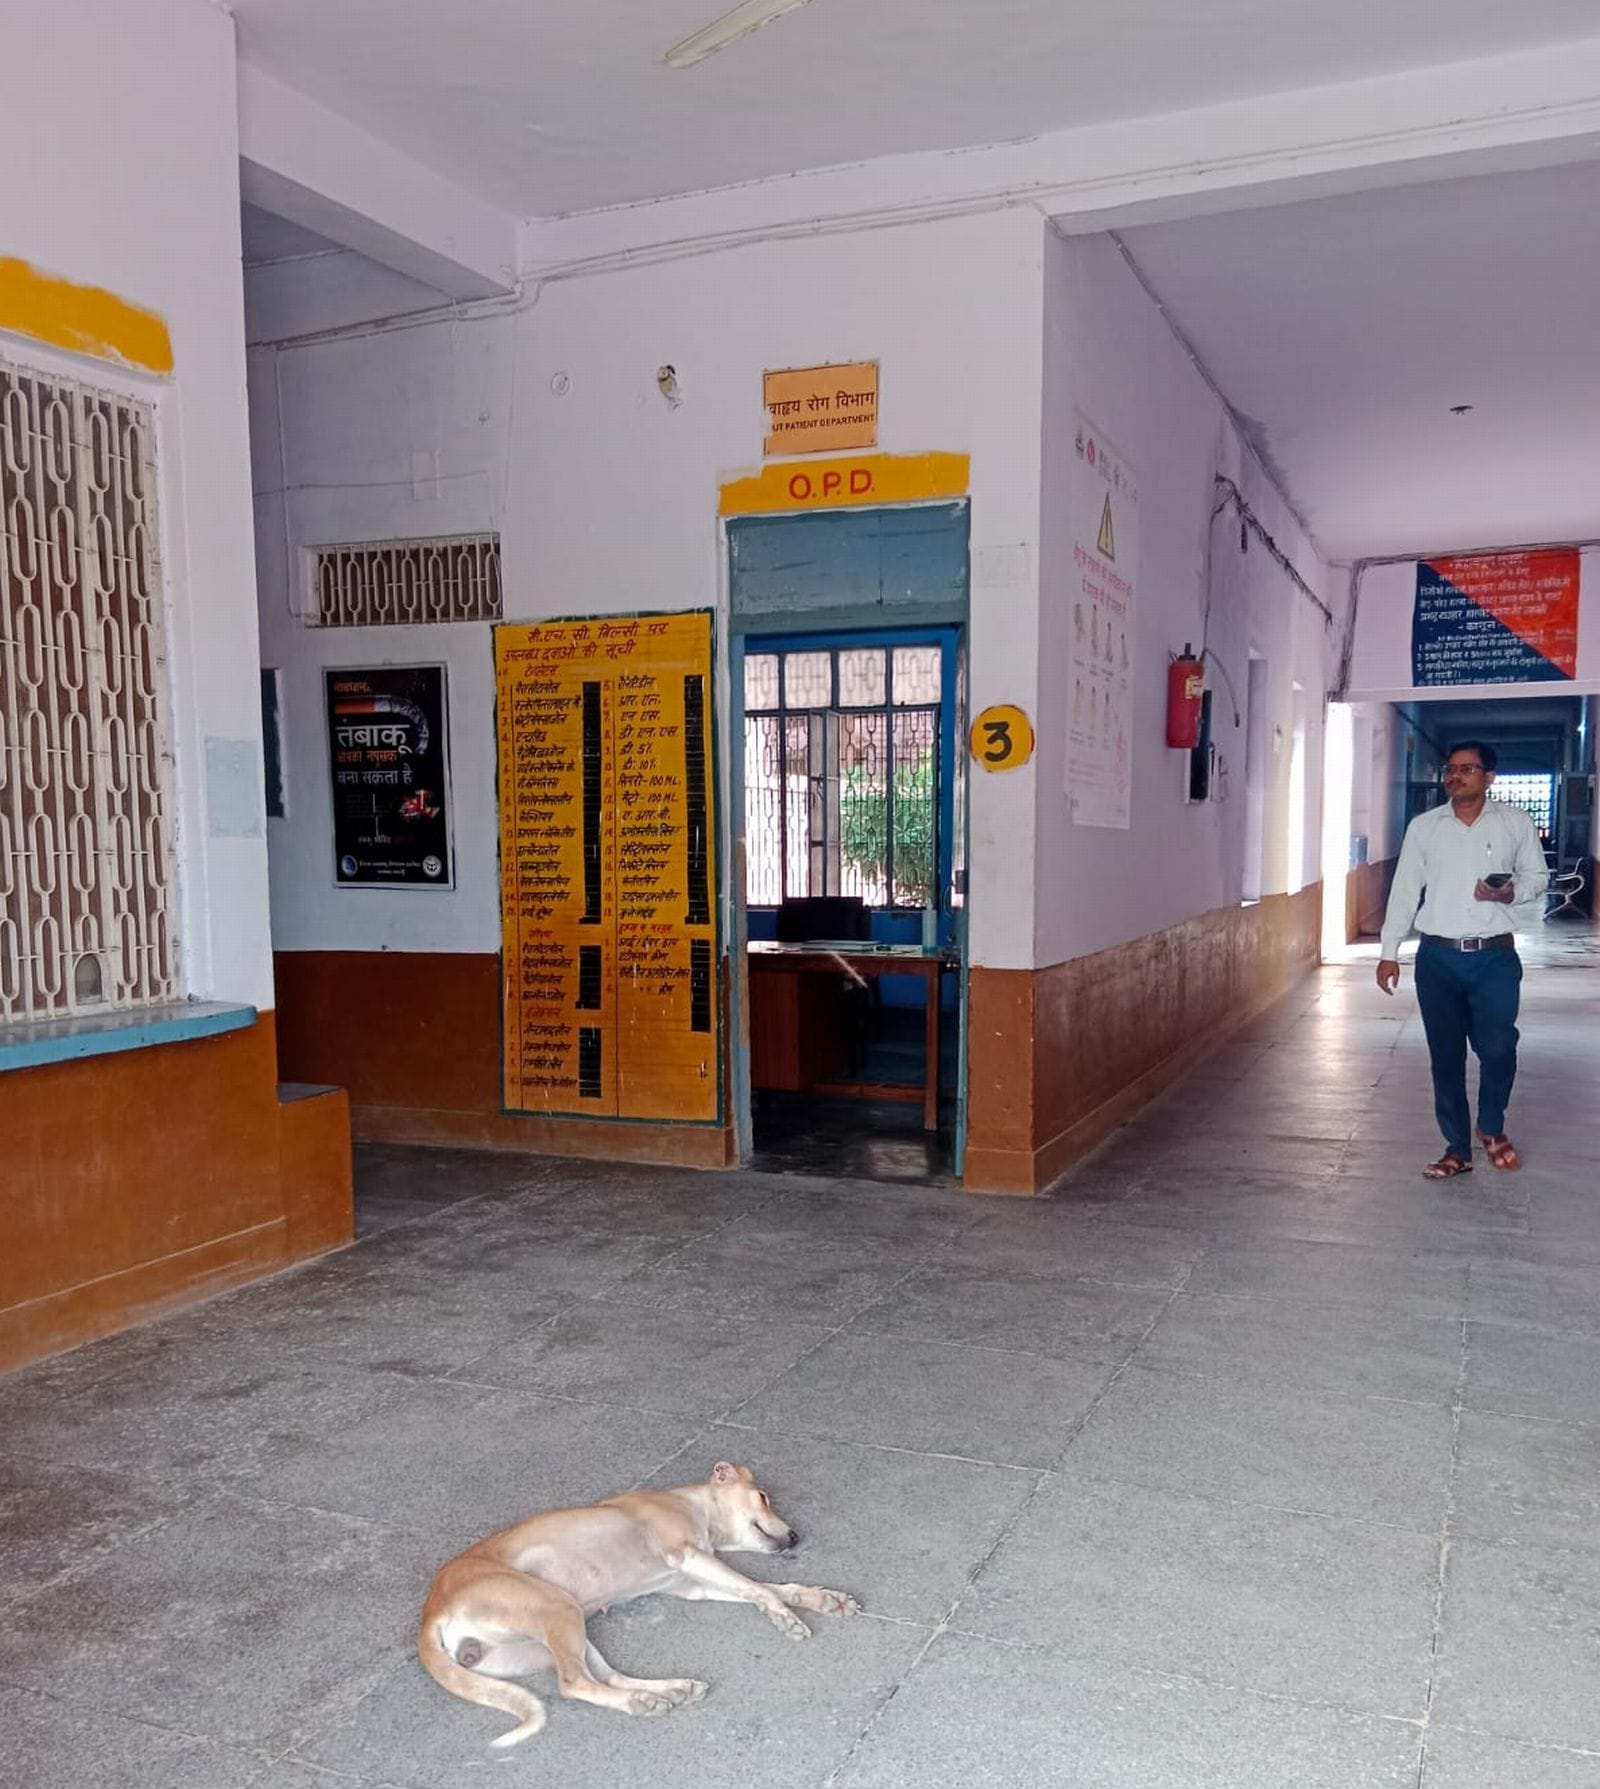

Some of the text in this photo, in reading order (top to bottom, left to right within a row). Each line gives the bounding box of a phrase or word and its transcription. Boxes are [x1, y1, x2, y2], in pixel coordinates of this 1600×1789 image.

[806, 394, 830, 411] रोग
[836, 391, 875, 409] विभाग
[772, 414, 874, 432] UT PATIENT DEPARTMENT
[648, 622, 670, 636] पर
[582, 641, 599, 657] की
[606, 638, 636, 660] सूची
[335, 718, 413, 754] तंबाकू
[983, 721, 1013, 762] 3
[362, 769, 400, 784] सकता
[402, 762, 414, 784] है
